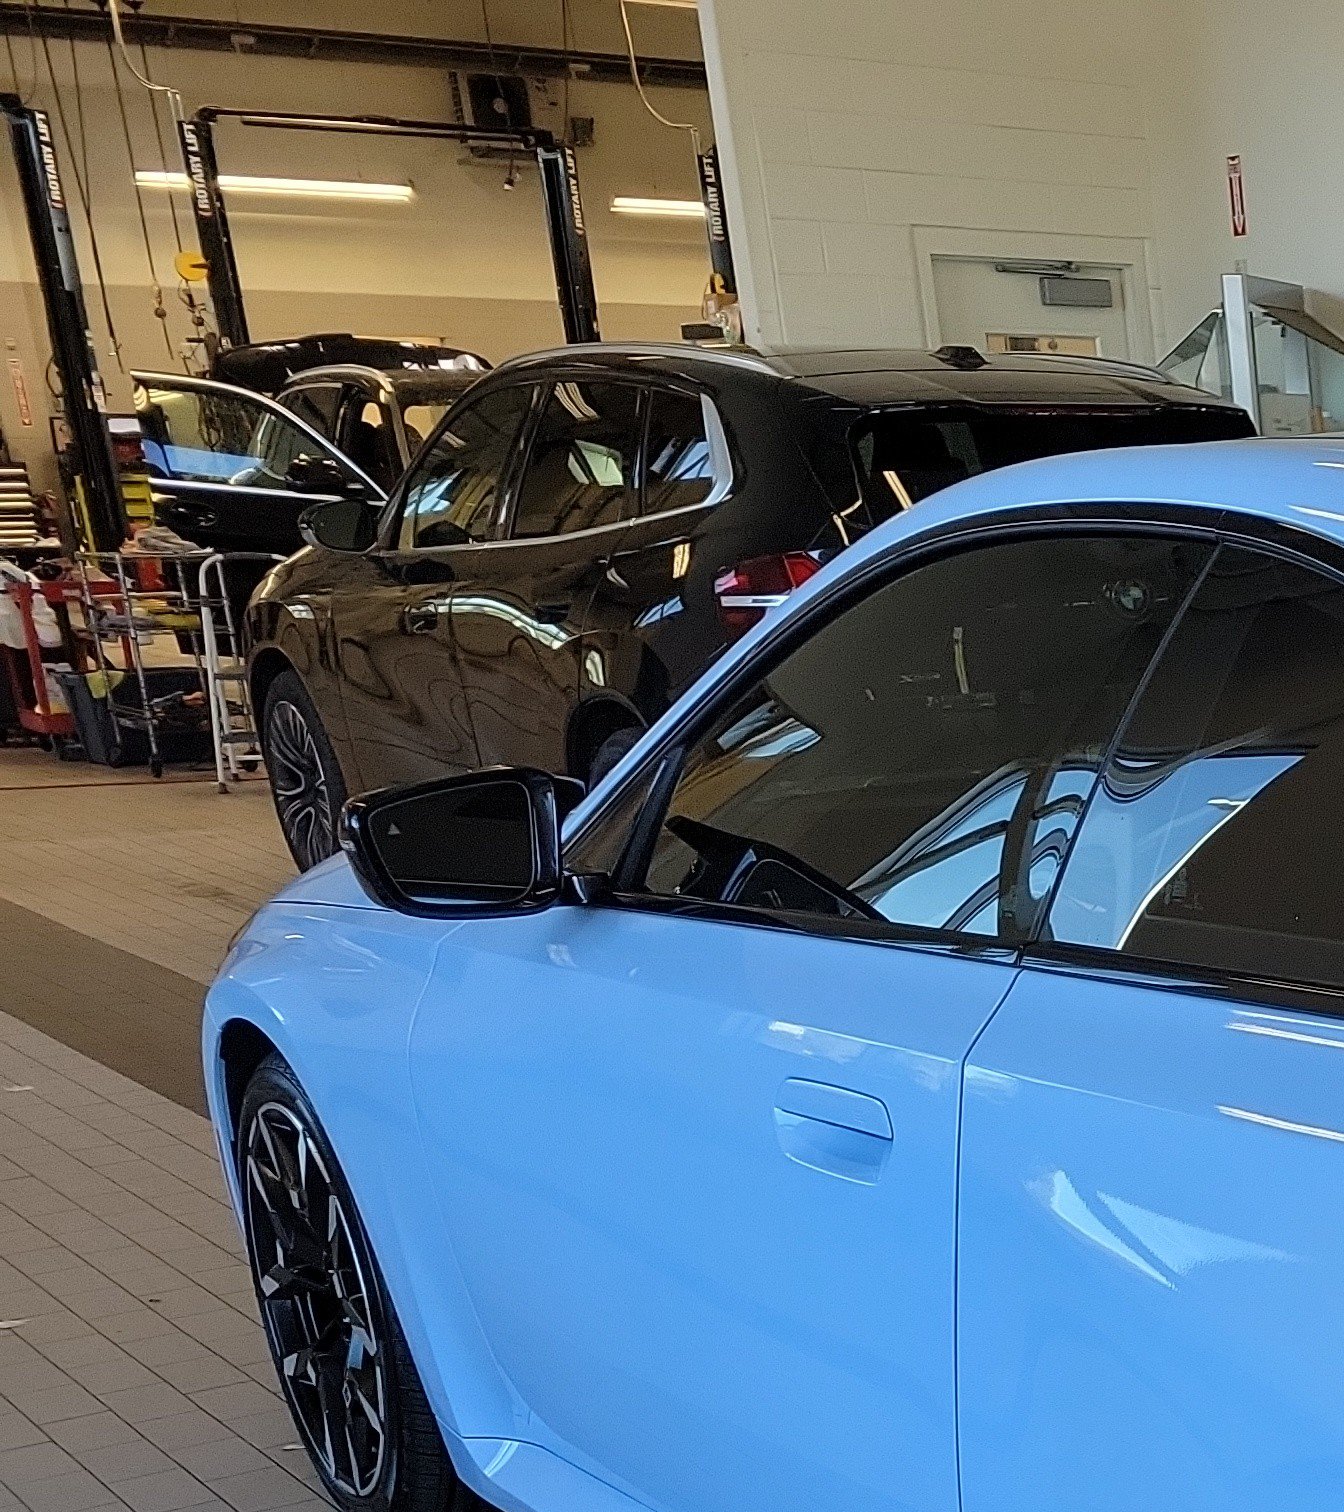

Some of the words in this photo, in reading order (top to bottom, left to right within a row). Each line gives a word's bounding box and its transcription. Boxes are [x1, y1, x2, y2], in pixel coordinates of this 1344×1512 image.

[34, 110, 51, 142] LIFT
[183, 122, 199, 151] LIFT
[40, 145, 62, 201] ROTARY
[188, 153, 211, 211] ROTARY
